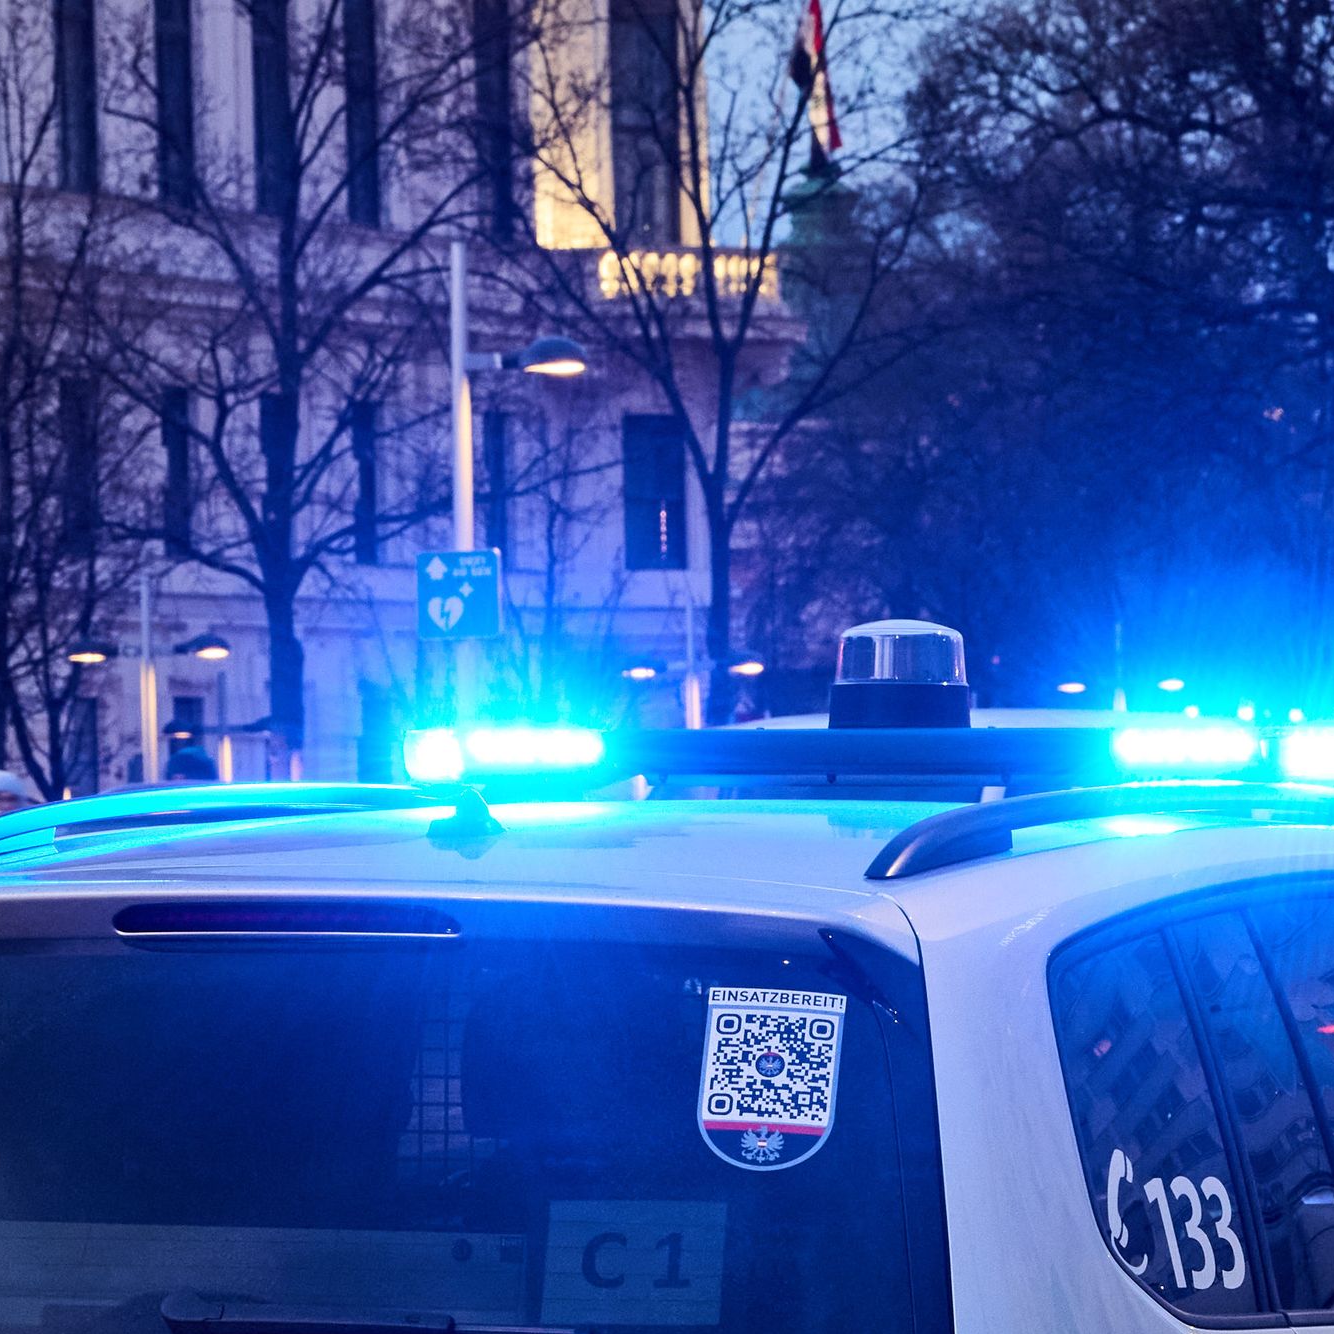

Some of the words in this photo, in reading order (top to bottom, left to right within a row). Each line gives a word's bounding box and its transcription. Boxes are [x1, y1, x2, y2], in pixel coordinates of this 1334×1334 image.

[711, 990, 844, 1010] EINSATZBEREIT!
[581, 1231, 628, 1289] C
[652, 1231, 691, 1289] 1
[1143, 1175, 1246, 1290] 133
